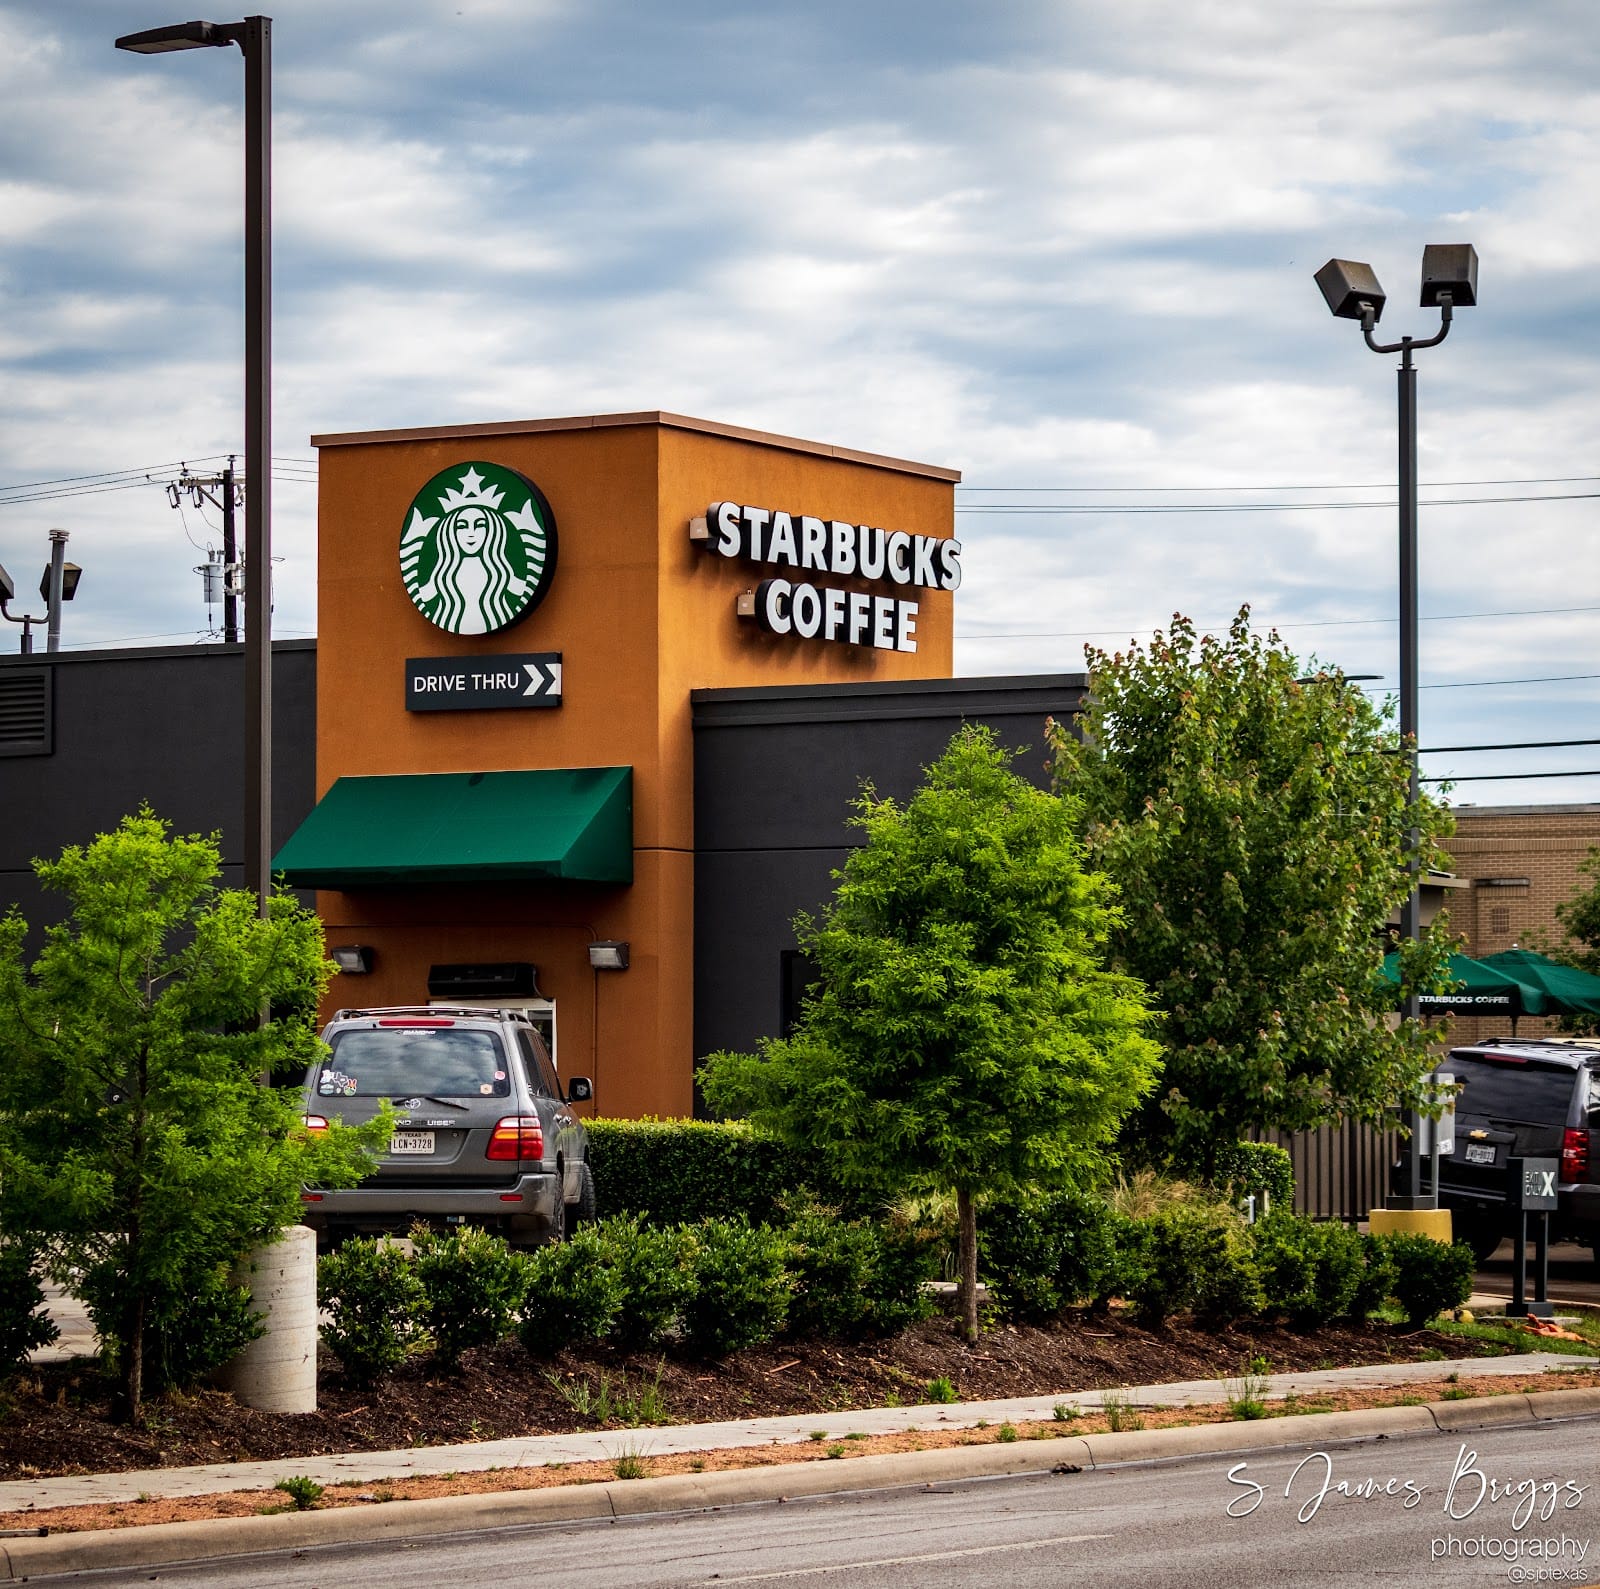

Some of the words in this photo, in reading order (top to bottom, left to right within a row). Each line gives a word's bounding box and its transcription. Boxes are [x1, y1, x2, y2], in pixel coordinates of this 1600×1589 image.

[712, 501, 962, 591] STARBUCKS
[763, 578, 919, 653] COFFEE
[413, 674, 466, 692] DRIVE
[471, 672, 519, 690] THRU
[1418, 995, 1473, 1004] STARBUCKS
[1475, 996, 1510, 1004] COFFEE
[1525, 1171, 1540, 1183] EXIT
[1541, 1171, 1556, 1197] X
[1525, 1184, 1542, 1196] ONLY
